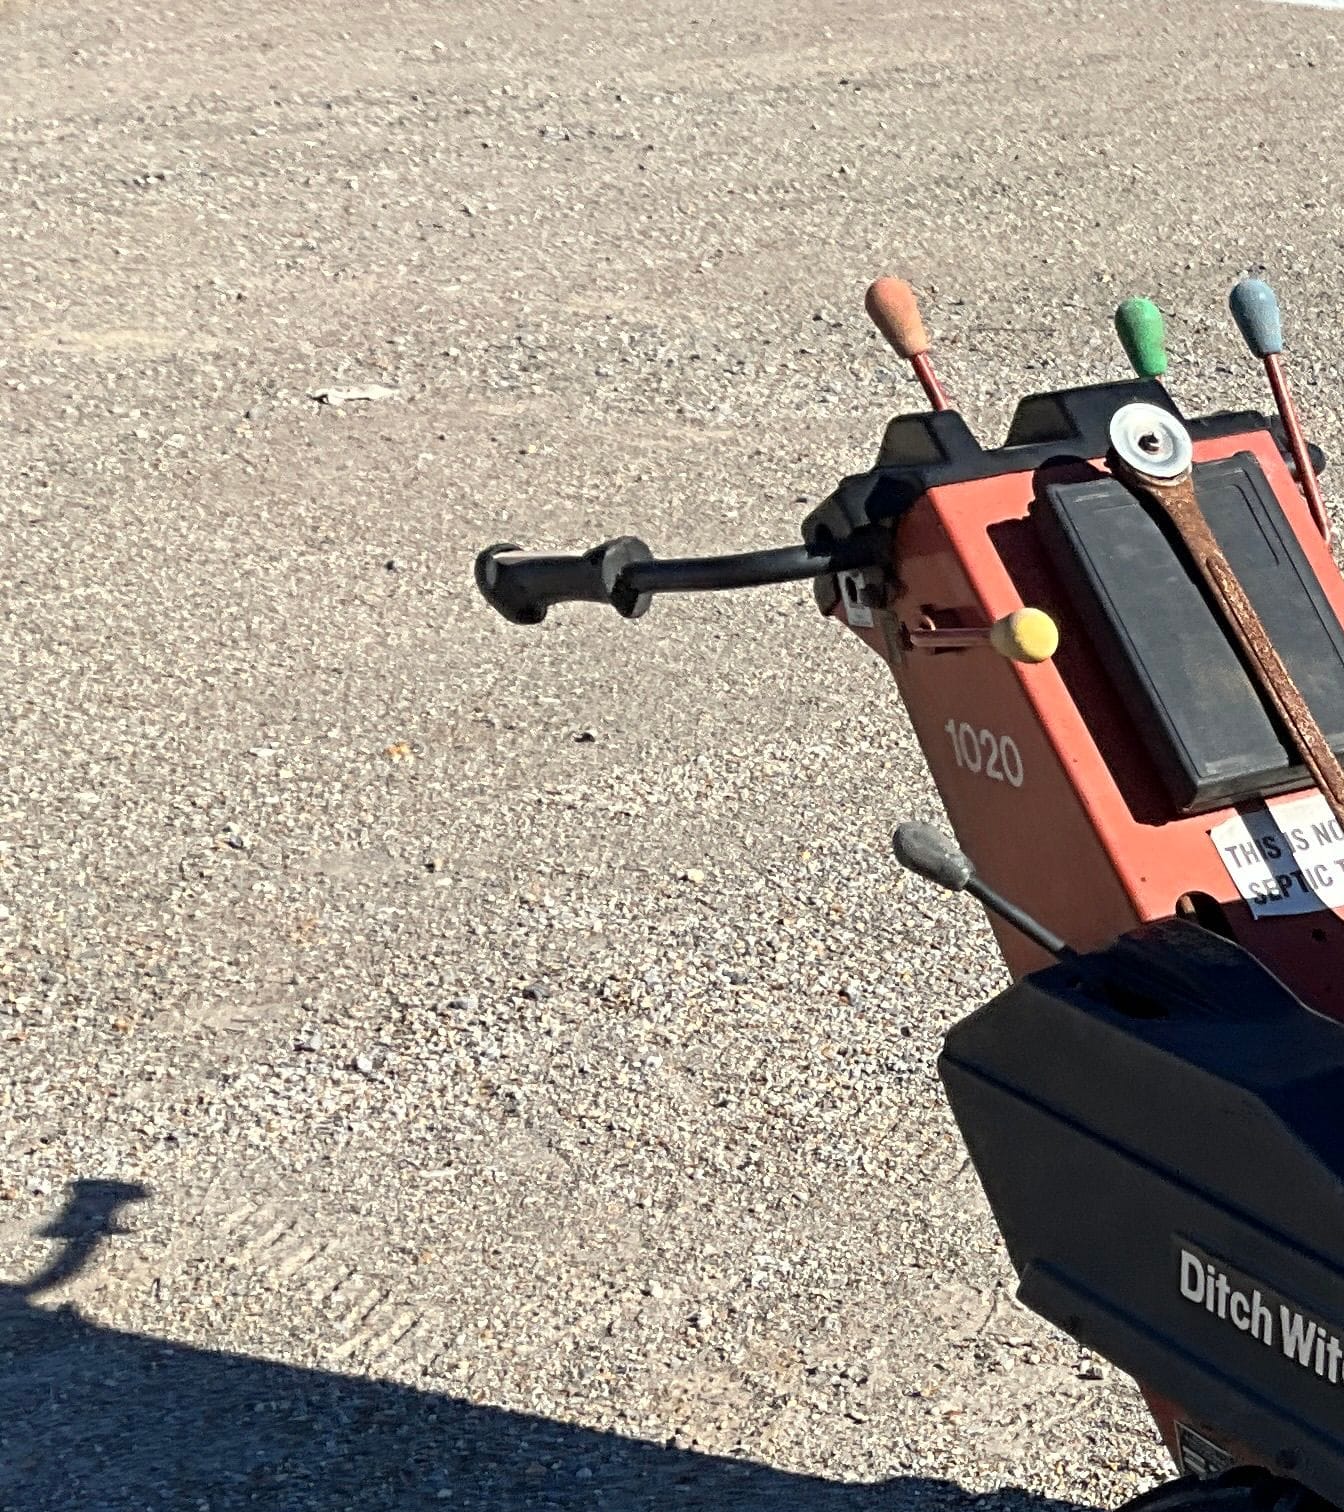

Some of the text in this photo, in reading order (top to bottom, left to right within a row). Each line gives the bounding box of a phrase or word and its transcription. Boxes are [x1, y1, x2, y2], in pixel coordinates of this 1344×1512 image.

[943, 718, 1024, 788] 1020
[1225, 835, 1282, 868] THIS
[1284, 828, 1310, 853] IS
[1248, 864, 1334, 905] SEPTIC
[1180, 1249, 1273, 1347] Ditch
